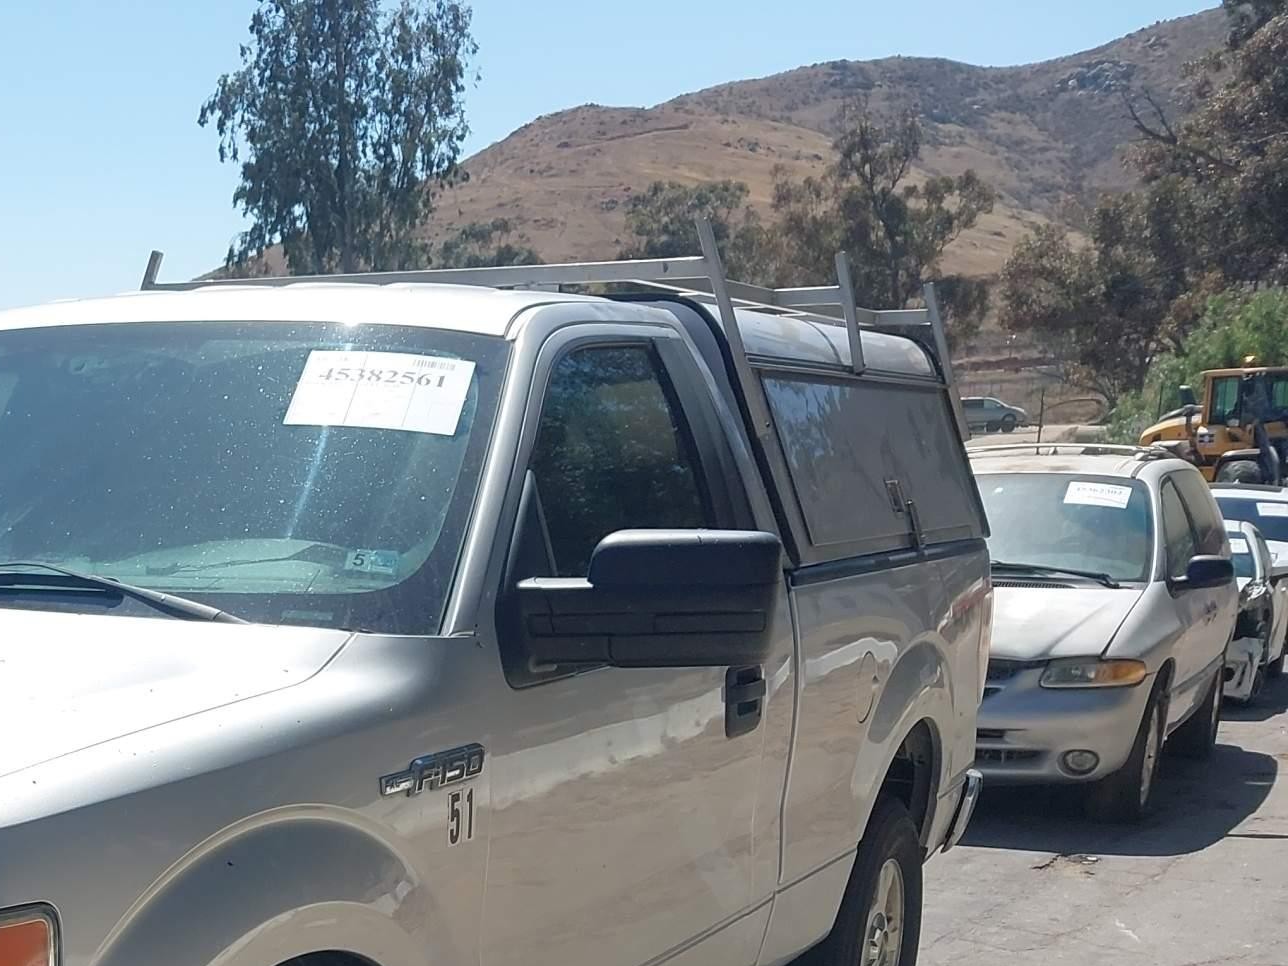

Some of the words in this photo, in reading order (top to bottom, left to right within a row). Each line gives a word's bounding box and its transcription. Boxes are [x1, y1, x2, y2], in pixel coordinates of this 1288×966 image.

[318, 367, 446, 389] 45382561
[351, 553, 366, 567] 5
[448, 787, 474, 845] 51
